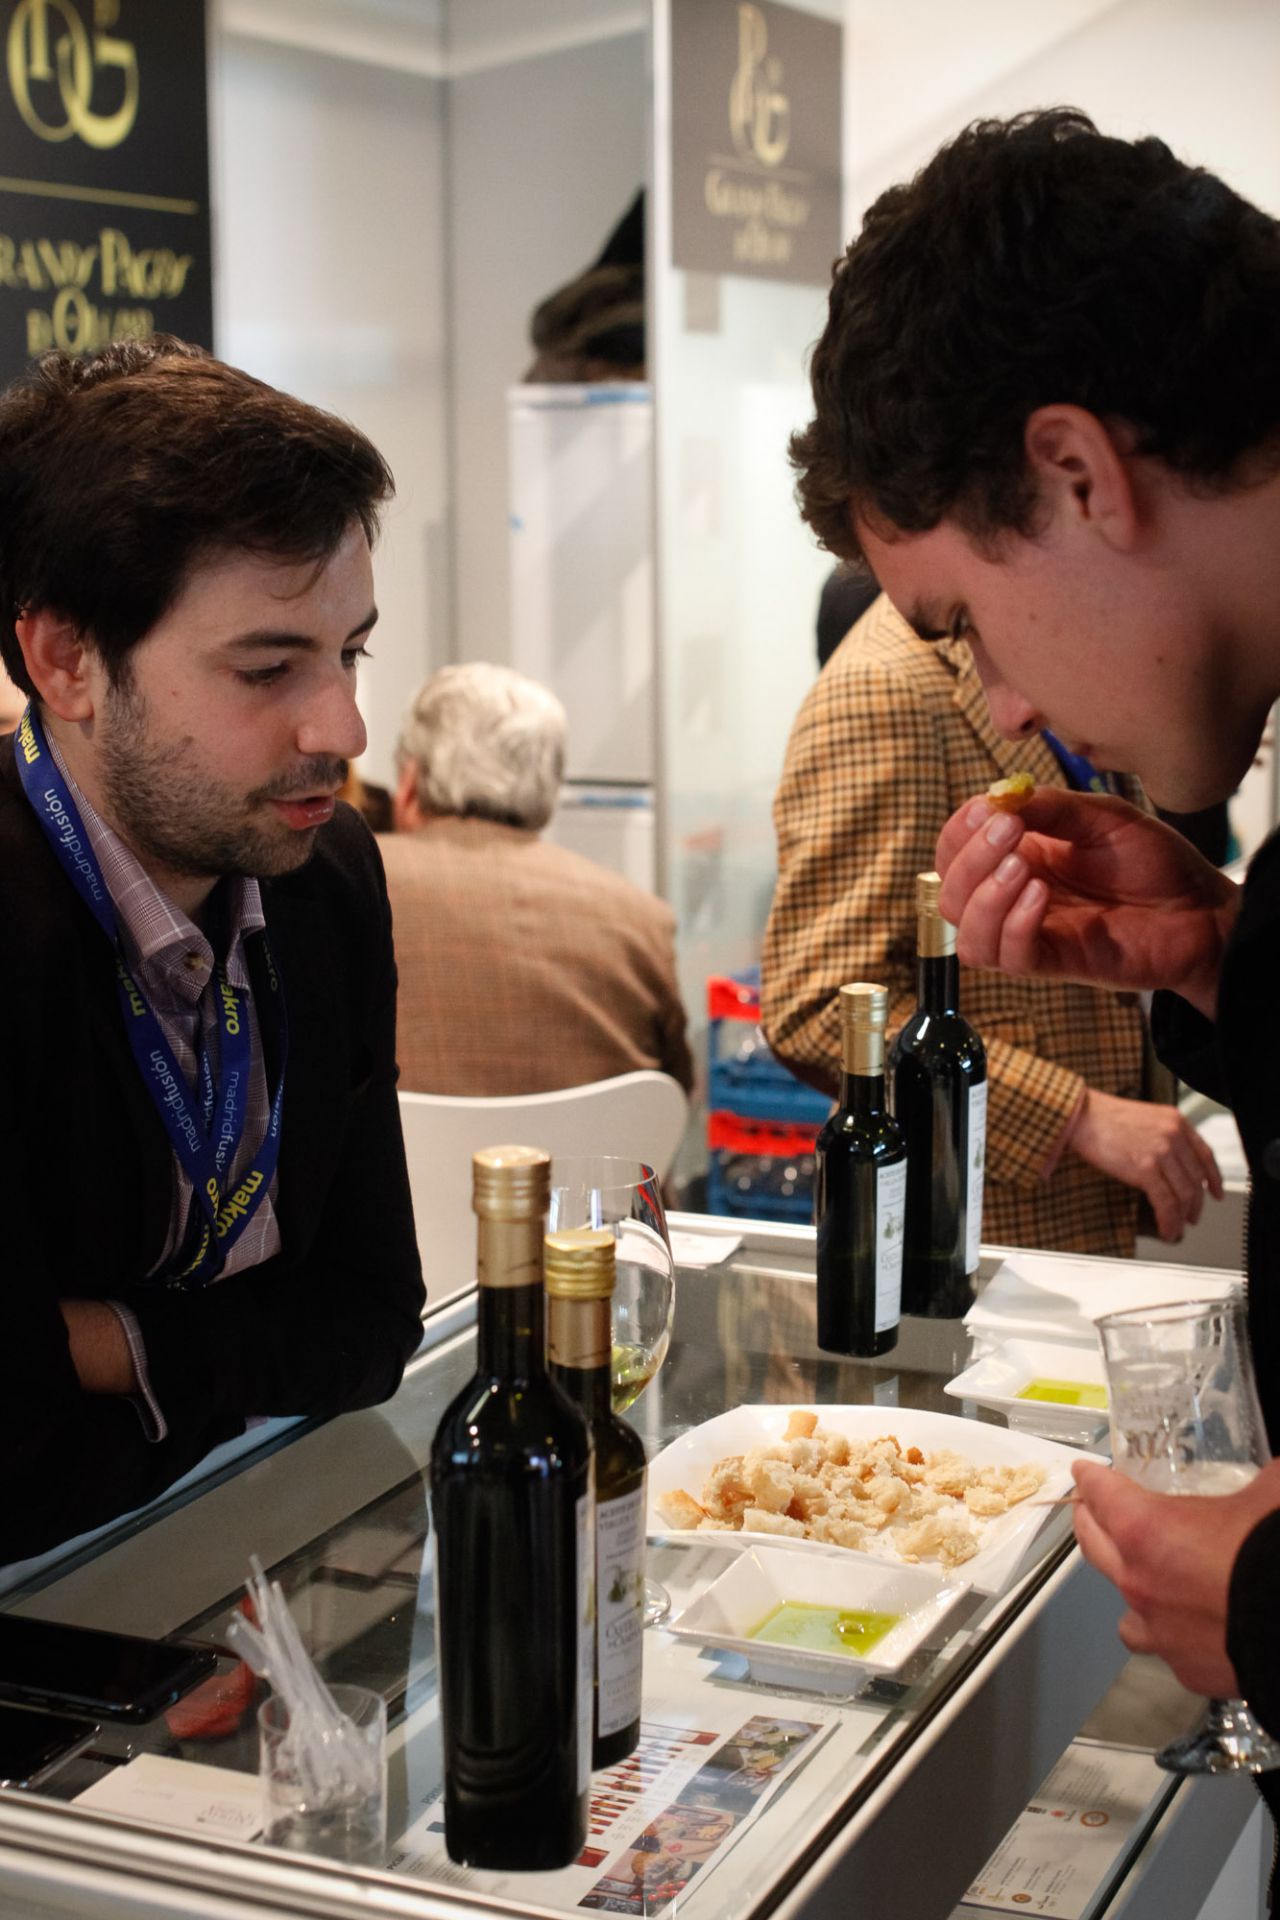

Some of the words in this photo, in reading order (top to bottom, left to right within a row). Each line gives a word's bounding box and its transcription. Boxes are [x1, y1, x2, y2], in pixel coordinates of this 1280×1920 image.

[44, 788, 103, 901] madridfusión
[150, 1048, 200, 1153] madridfusión
[216, 1169, 265, 1238] makro
